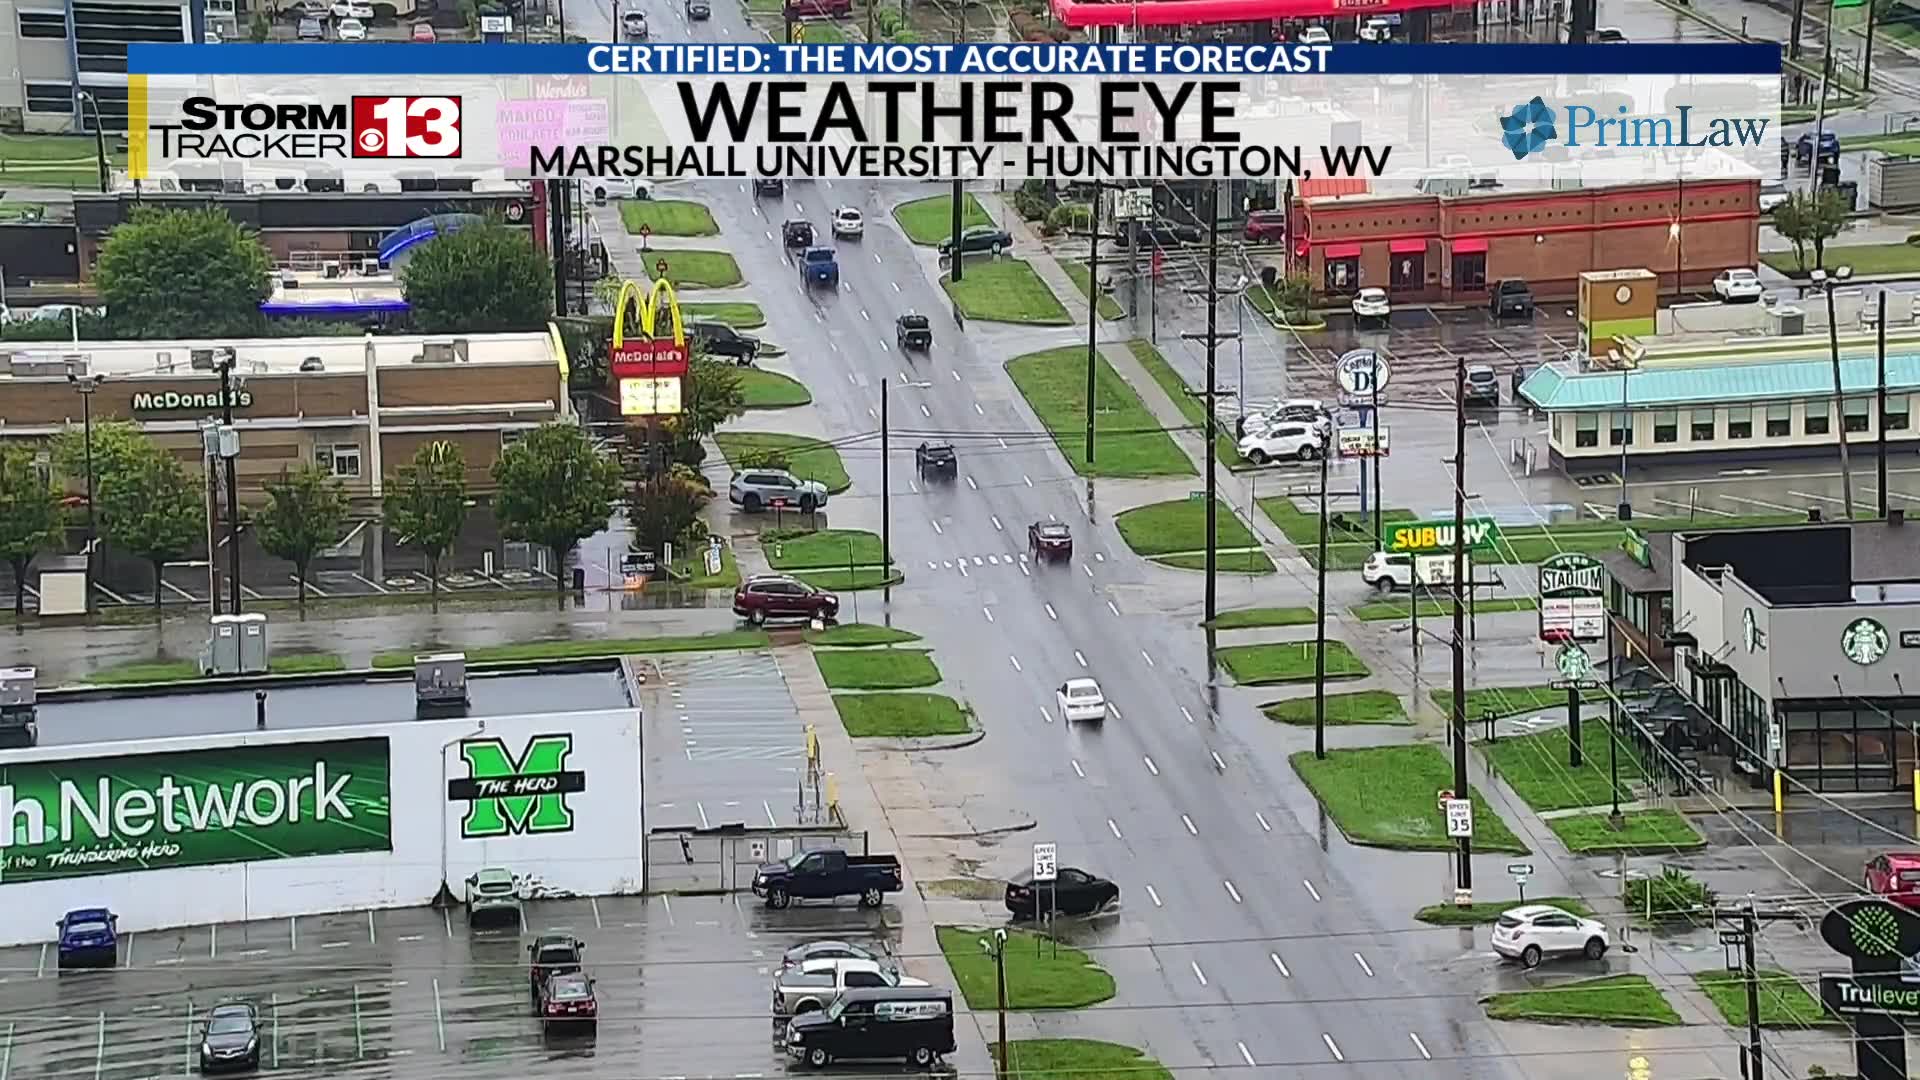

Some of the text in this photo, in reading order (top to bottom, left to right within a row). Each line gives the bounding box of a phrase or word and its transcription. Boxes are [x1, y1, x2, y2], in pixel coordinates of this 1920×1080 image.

[614, 351, 683, 362] McDonald's
[133, 391, 252, 409] McDonald's
[1392, 523, 1491, 552] SUBWAY
[1543, 567, 1602, 590] STADIUM
[475, 777, 558, 796] THE HERD
[60, 761, 354, 842] Network
[1036, 862, 1055, 875] 35
